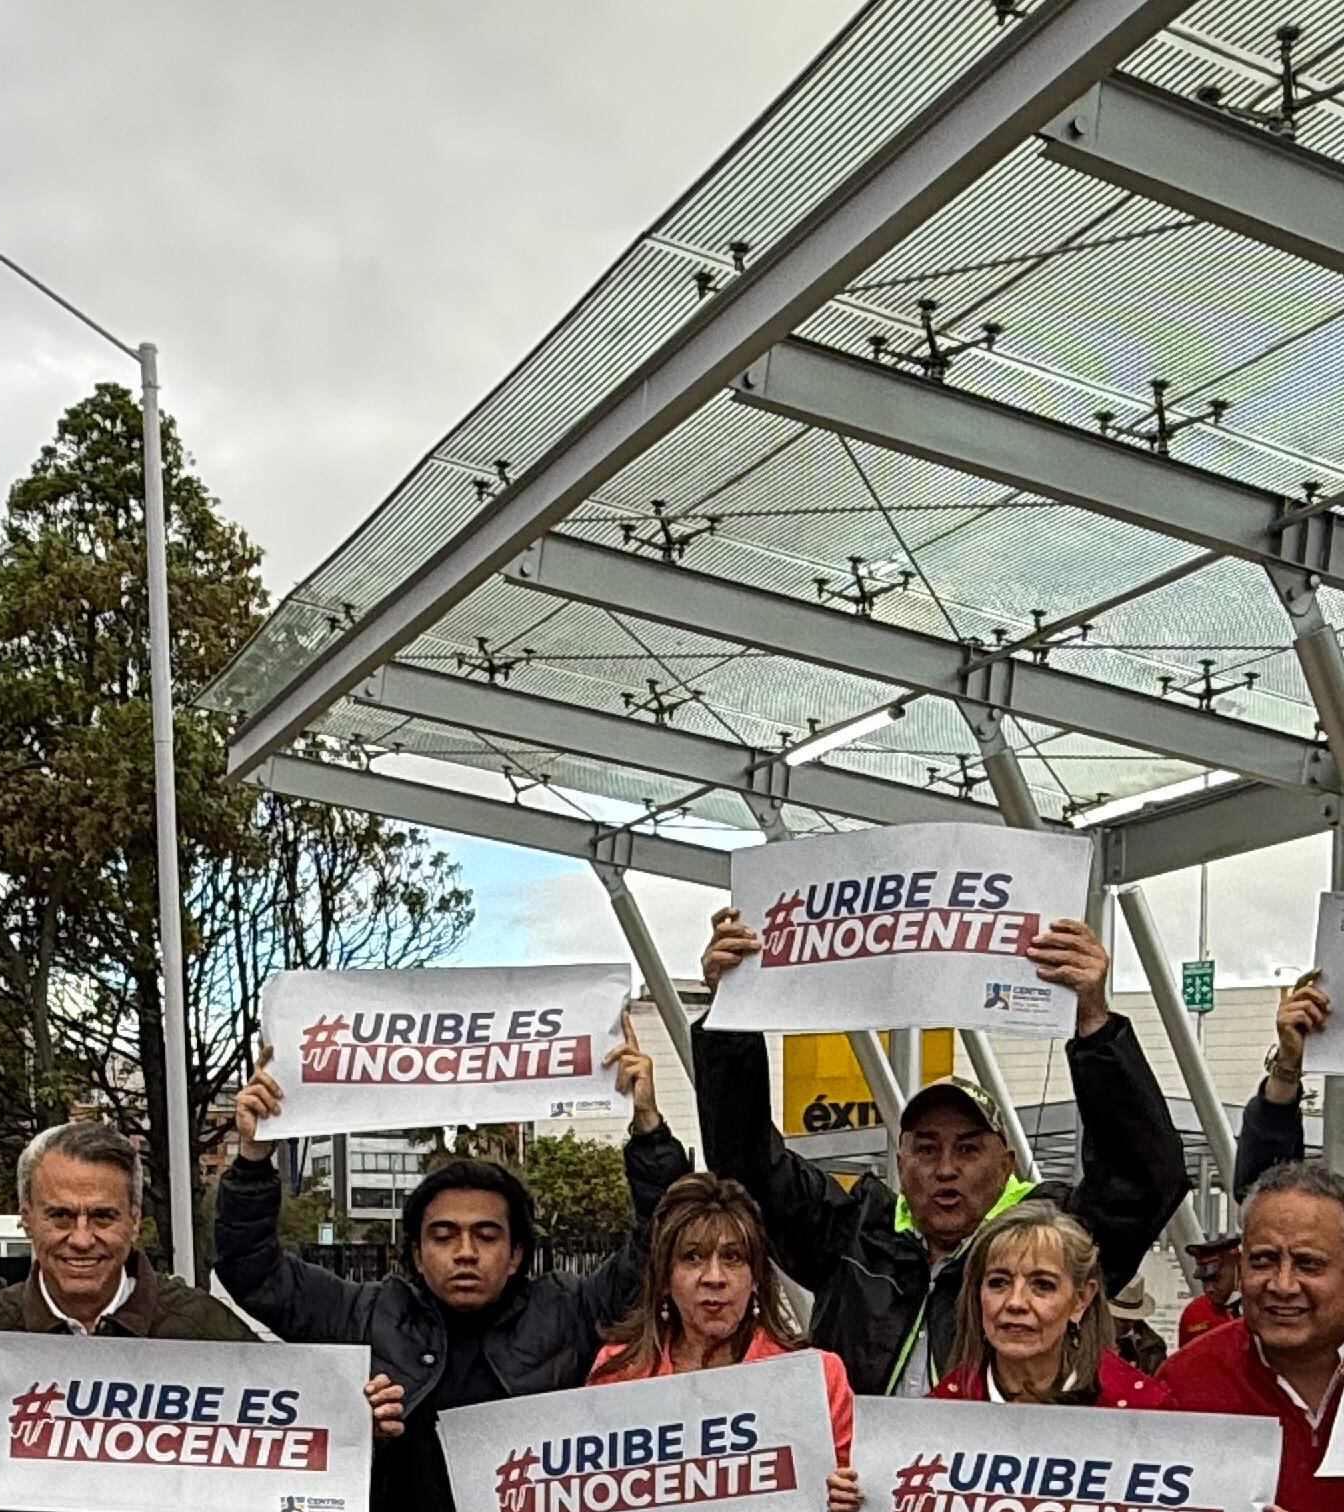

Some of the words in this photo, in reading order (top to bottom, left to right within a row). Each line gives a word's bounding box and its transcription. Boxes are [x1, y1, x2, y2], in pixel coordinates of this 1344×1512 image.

[762, 871, 937, 952] #URIBE
[948, 871, 1014, 910] ES
[788, 912, 1025, 962] INOCENTE
[299, 1011, 495, 1068] #URIBE
[507, 1008, 564, 1040] ES
[335, 1039, 578, 1081] INOCENTE
[9, 1380, 224, 1441] #URIBE
[236, 1388, 300, 1426] ES
[46, 1420, 314, 1468] INOCENTE
[495, 1423, 683, 1509] #URIBE
[700, 1412, 758, 1455] ES
[1123, 1463, 1194, 1506] ES
